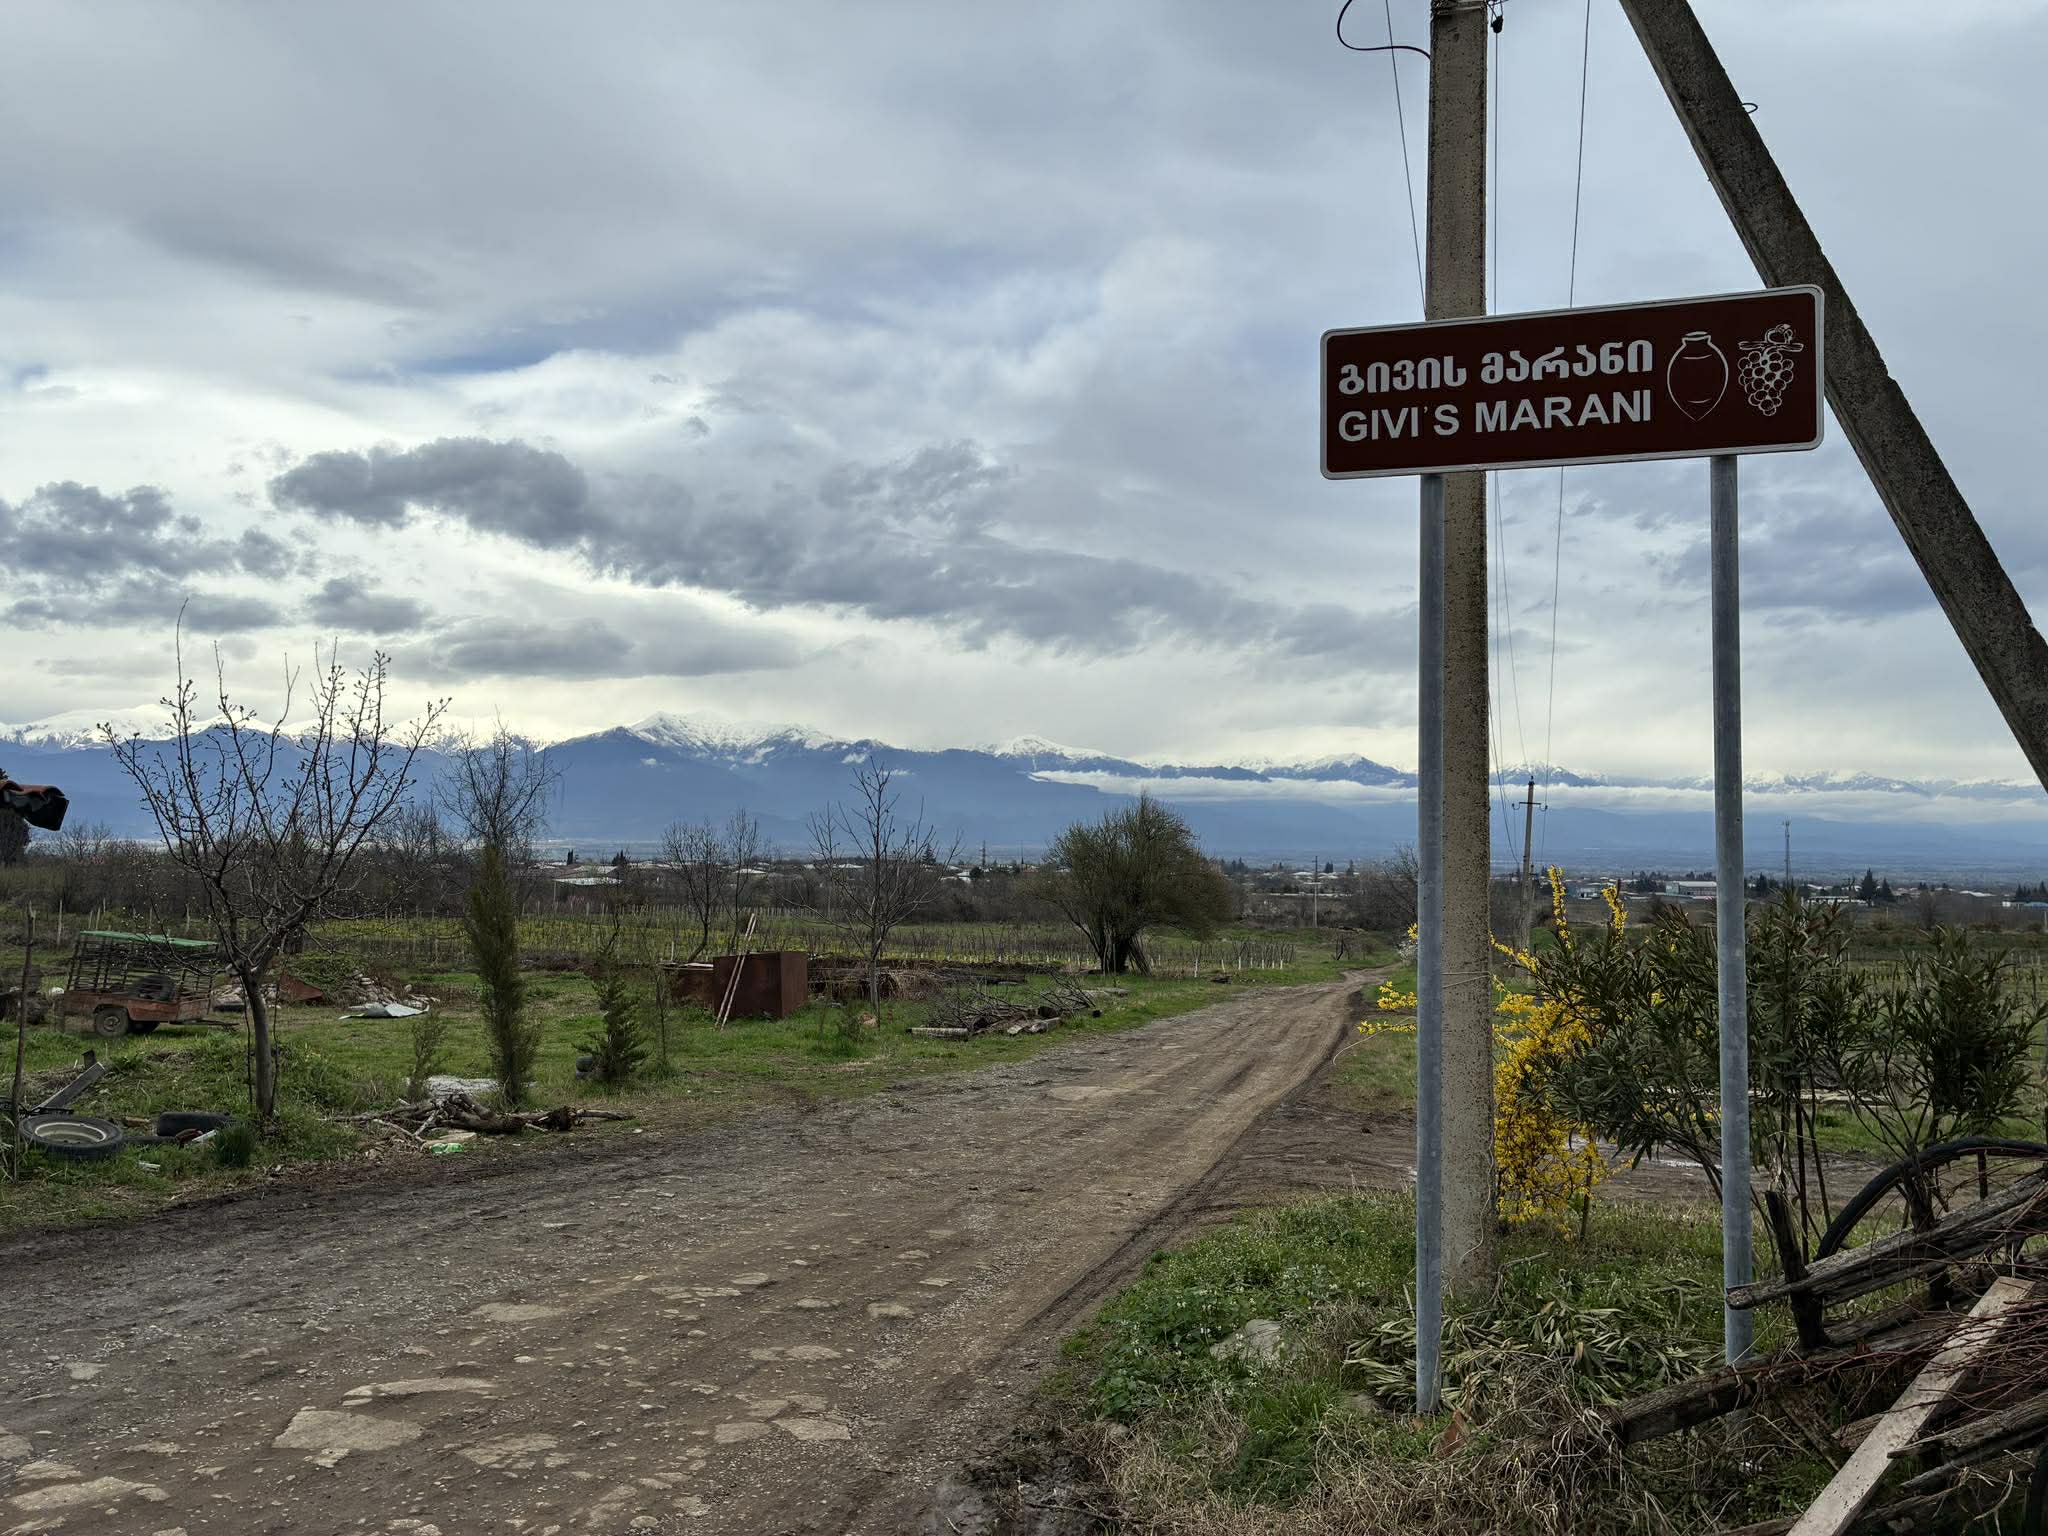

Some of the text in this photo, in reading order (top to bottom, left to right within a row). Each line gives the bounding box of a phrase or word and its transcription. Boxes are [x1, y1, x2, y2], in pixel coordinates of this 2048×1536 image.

[1338, 340, 1653, 395] გივის მარანი
[1338, 390, 1651, 442] GIVI'S MARANI
